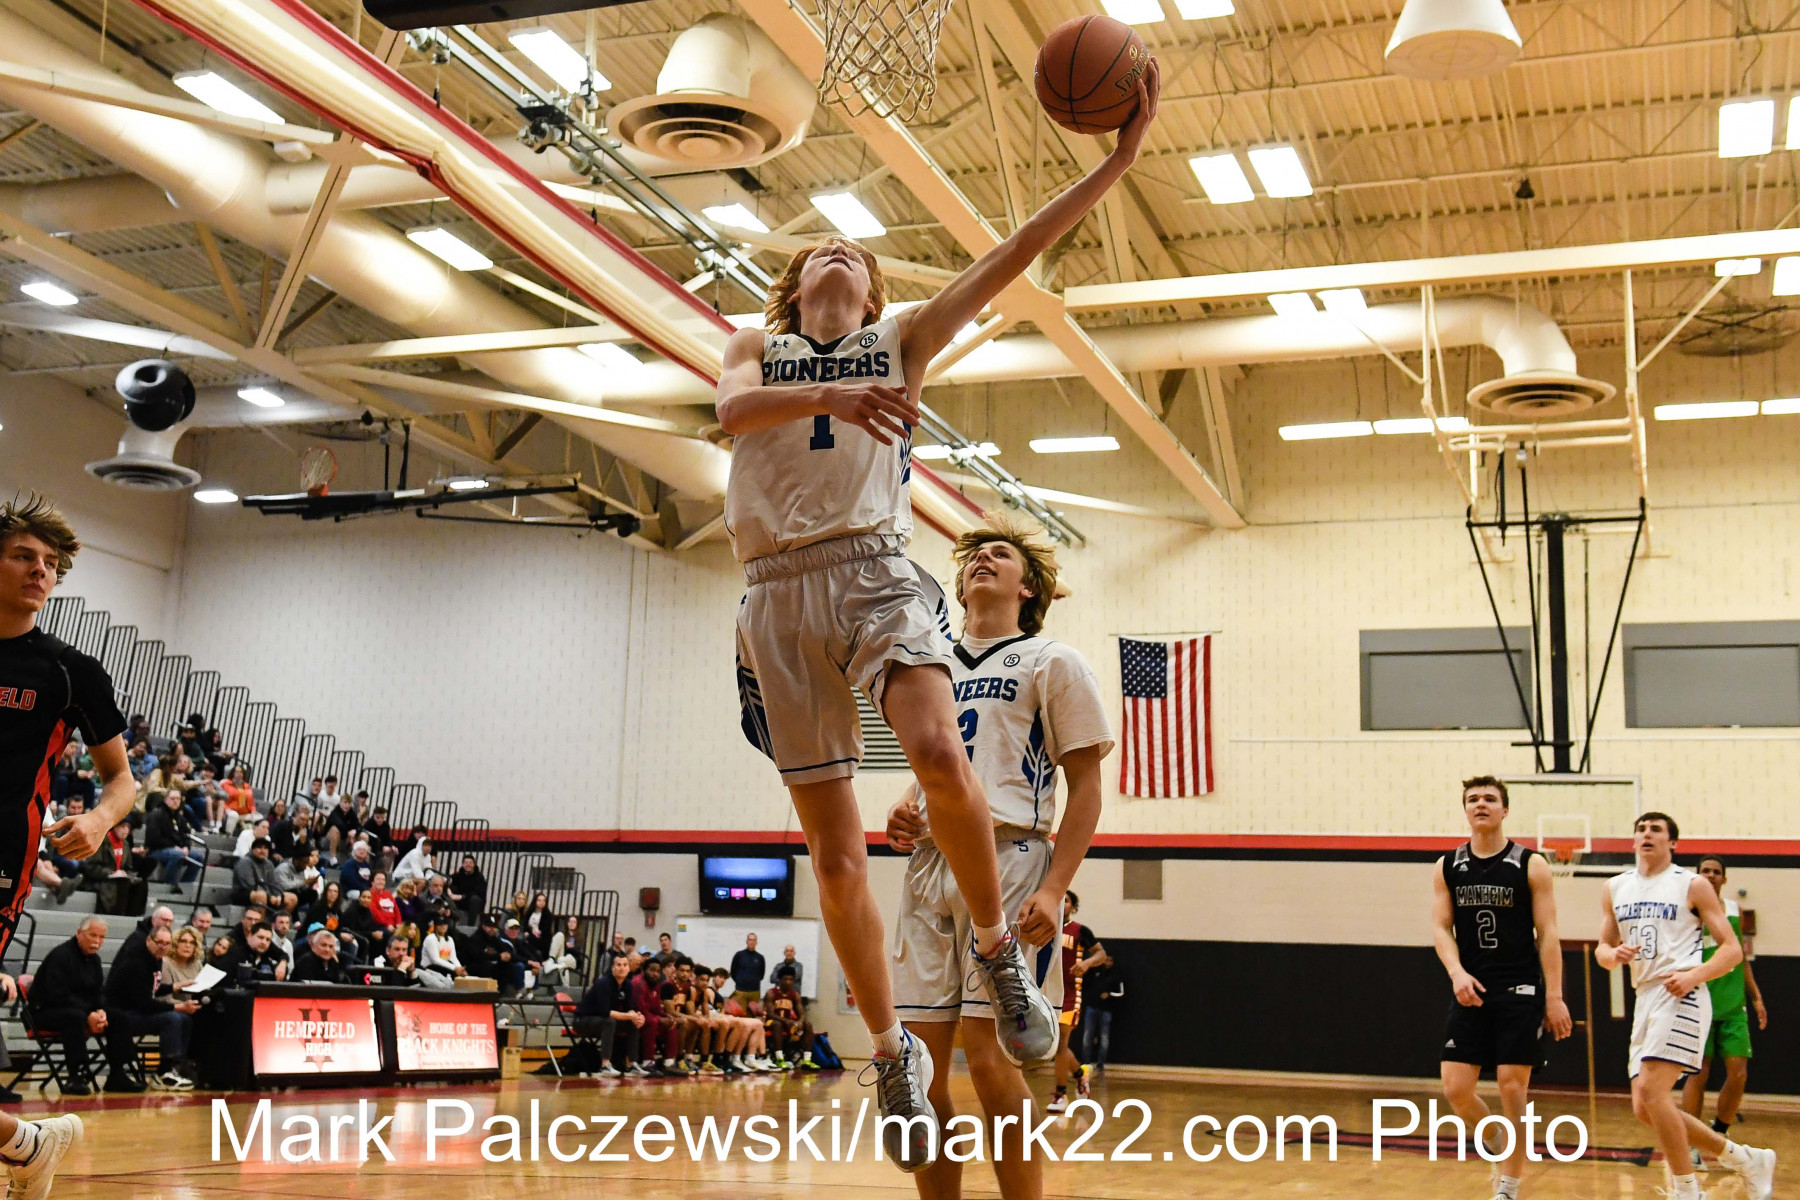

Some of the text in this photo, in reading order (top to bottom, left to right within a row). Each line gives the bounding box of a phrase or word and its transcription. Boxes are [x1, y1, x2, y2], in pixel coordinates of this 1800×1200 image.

[762, 351, 890, 386] PIONEERS
[809, 413, 835, 450] 1
[0, 686, 37, 711] ELD
[1456, 884, 1514, 907] MANHEIM
[1476, 909, 1498, 948] 2
[1629, 924, 1658, 961] 13
[274, 1020, 355, 1039] HEMPFIELD
[429, 1022, 488, 1035] HOME OF THE
[305, 1042, 332, 1056] HIGH
[441, 1038, 495, 1054] KNIGHTS
